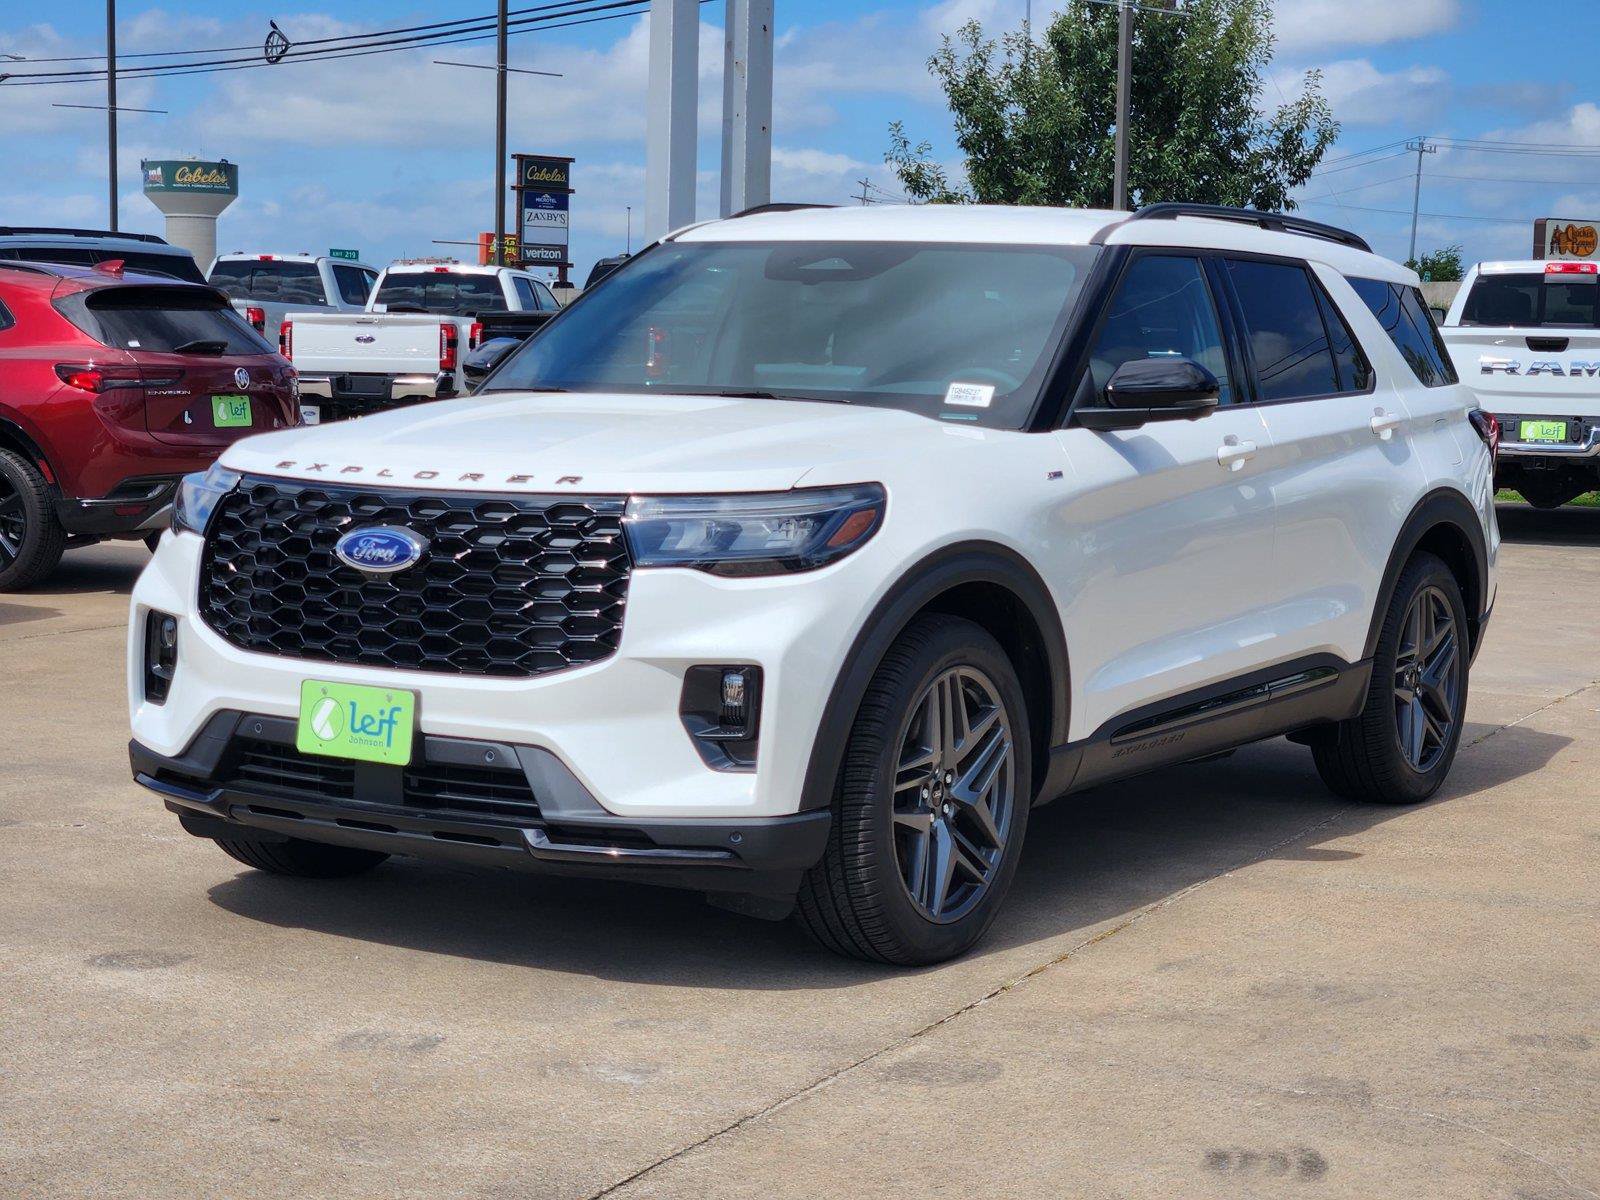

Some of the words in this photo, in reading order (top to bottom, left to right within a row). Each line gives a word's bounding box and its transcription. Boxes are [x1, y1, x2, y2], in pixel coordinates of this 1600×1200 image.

[175, 166, 228, 185] Cabela's
[526, 165, 566, 182] Cabela's
[526, 211, 566, 225] ZAXBY'S
[525, 247, 562, 259] verizon
[229, 401, 247, 420] leif
[1541, 425, 1563, 439] leif
[275, 460, 584, 485] EXPLORER
[352, 535, 399, 562] Ford
[349, 700, 402, 748] leif
[348, 735, 384, 748] Johnson
